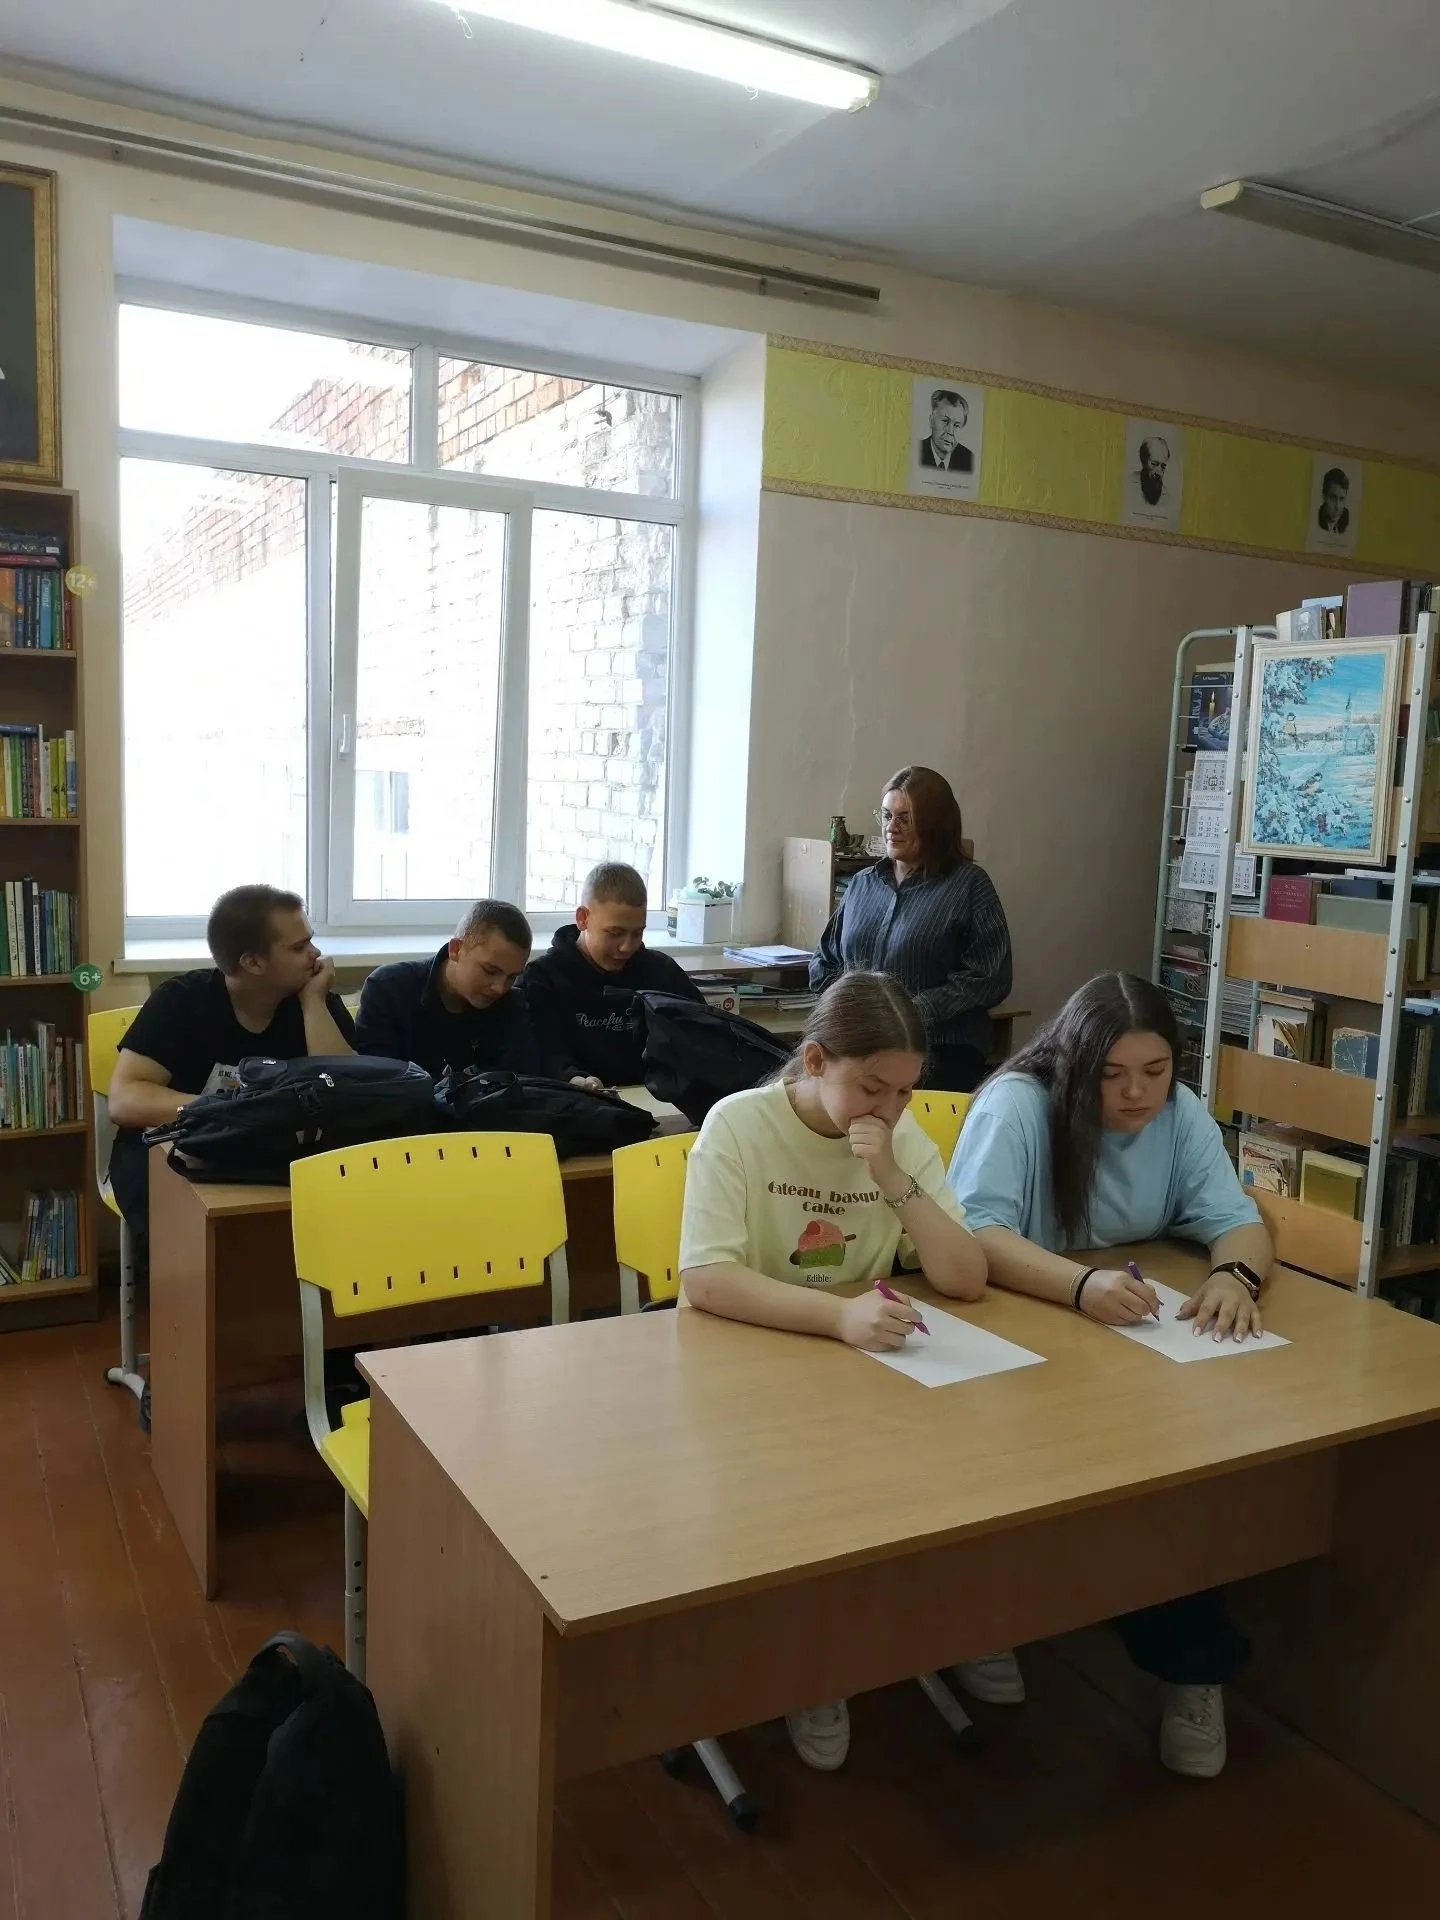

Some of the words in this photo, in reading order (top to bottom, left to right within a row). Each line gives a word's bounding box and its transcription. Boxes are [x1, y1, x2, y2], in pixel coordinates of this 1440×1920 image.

[68, 573, 95, 588] 12+
[80, 971, 101, 985] 6+
[802, 1201, 846, 1215] cake
[806, 1273, 832, 1284] Edible:
